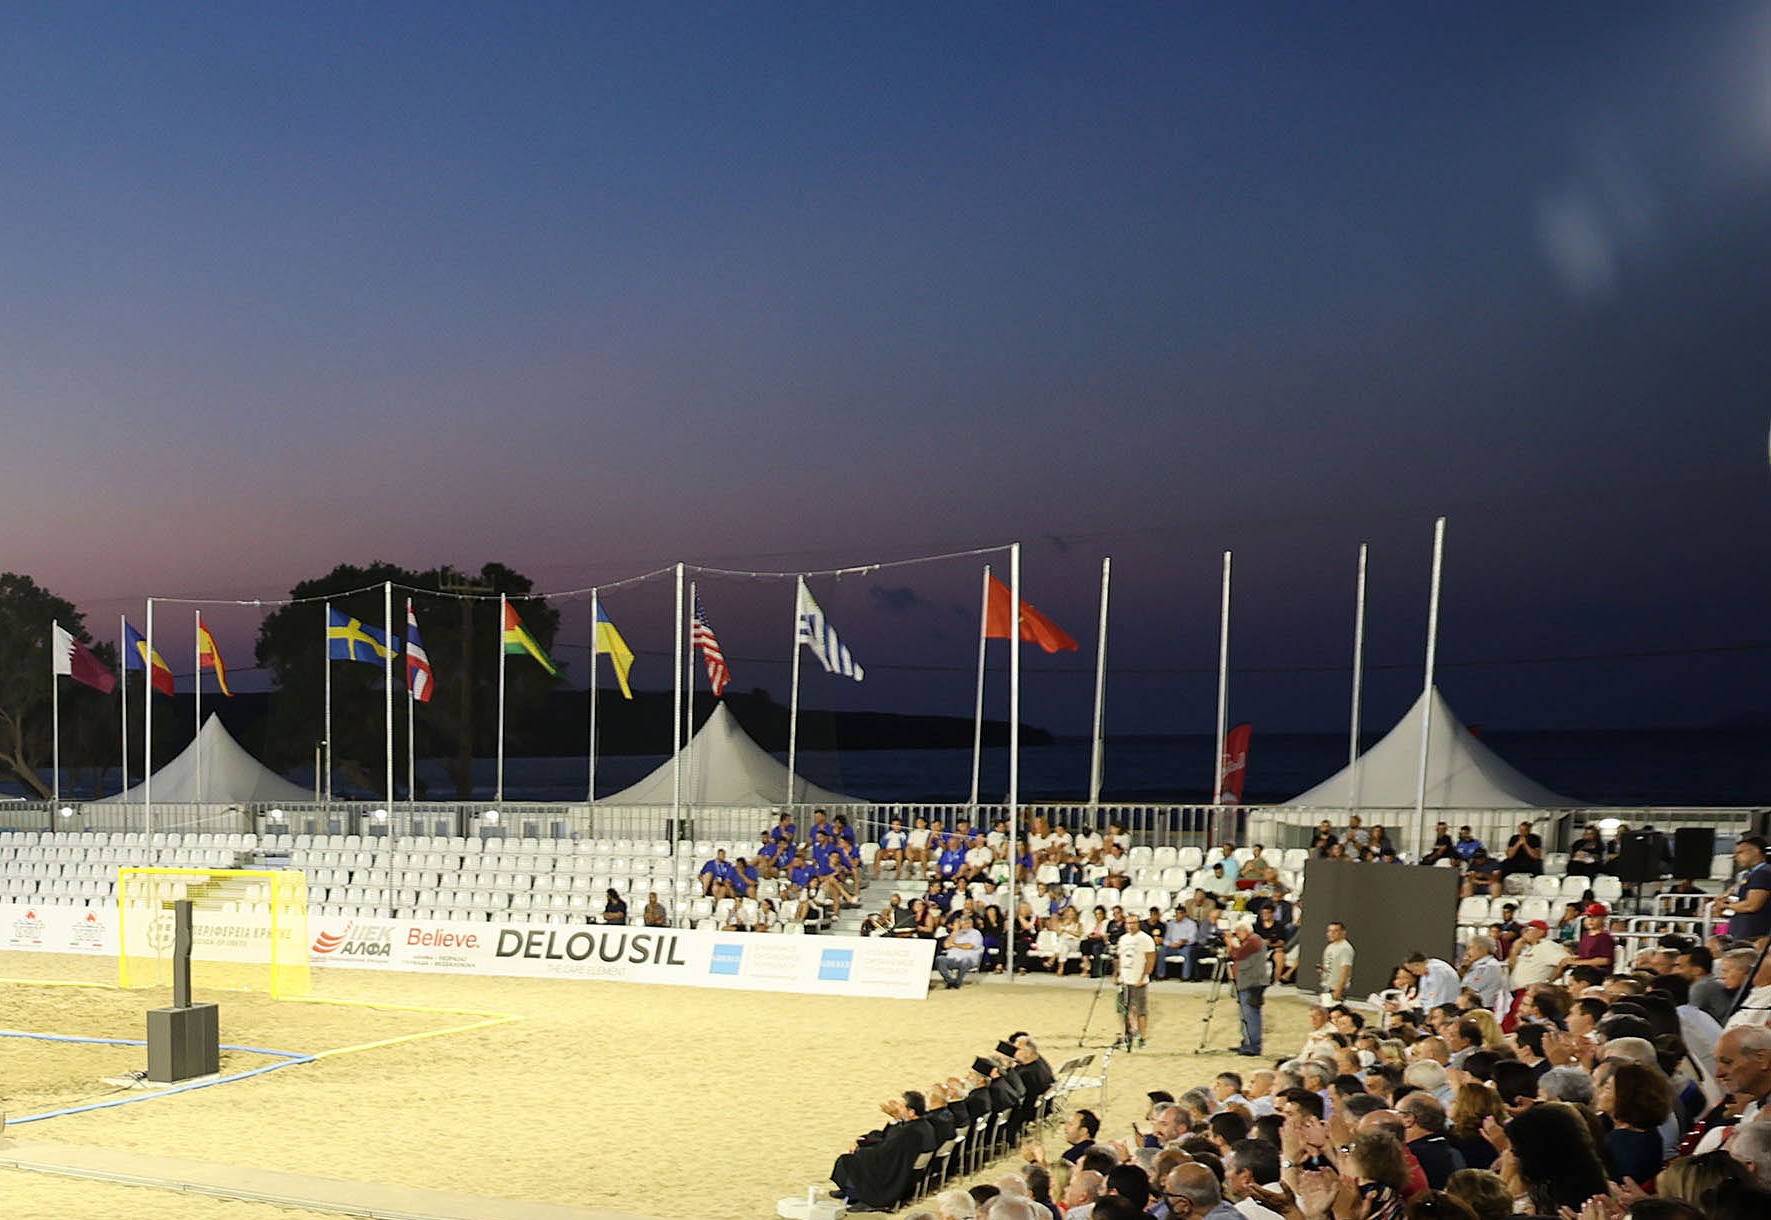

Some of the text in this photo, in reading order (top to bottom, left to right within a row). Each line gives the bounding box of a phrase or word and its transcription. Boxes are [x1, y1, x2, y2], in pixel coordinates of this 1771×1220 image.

[340, 941, 392, 956] ΑΛΦΑ
[407, 928, 480, 949] Believe.
[495, 929, 686, 965] DELOUSIL
